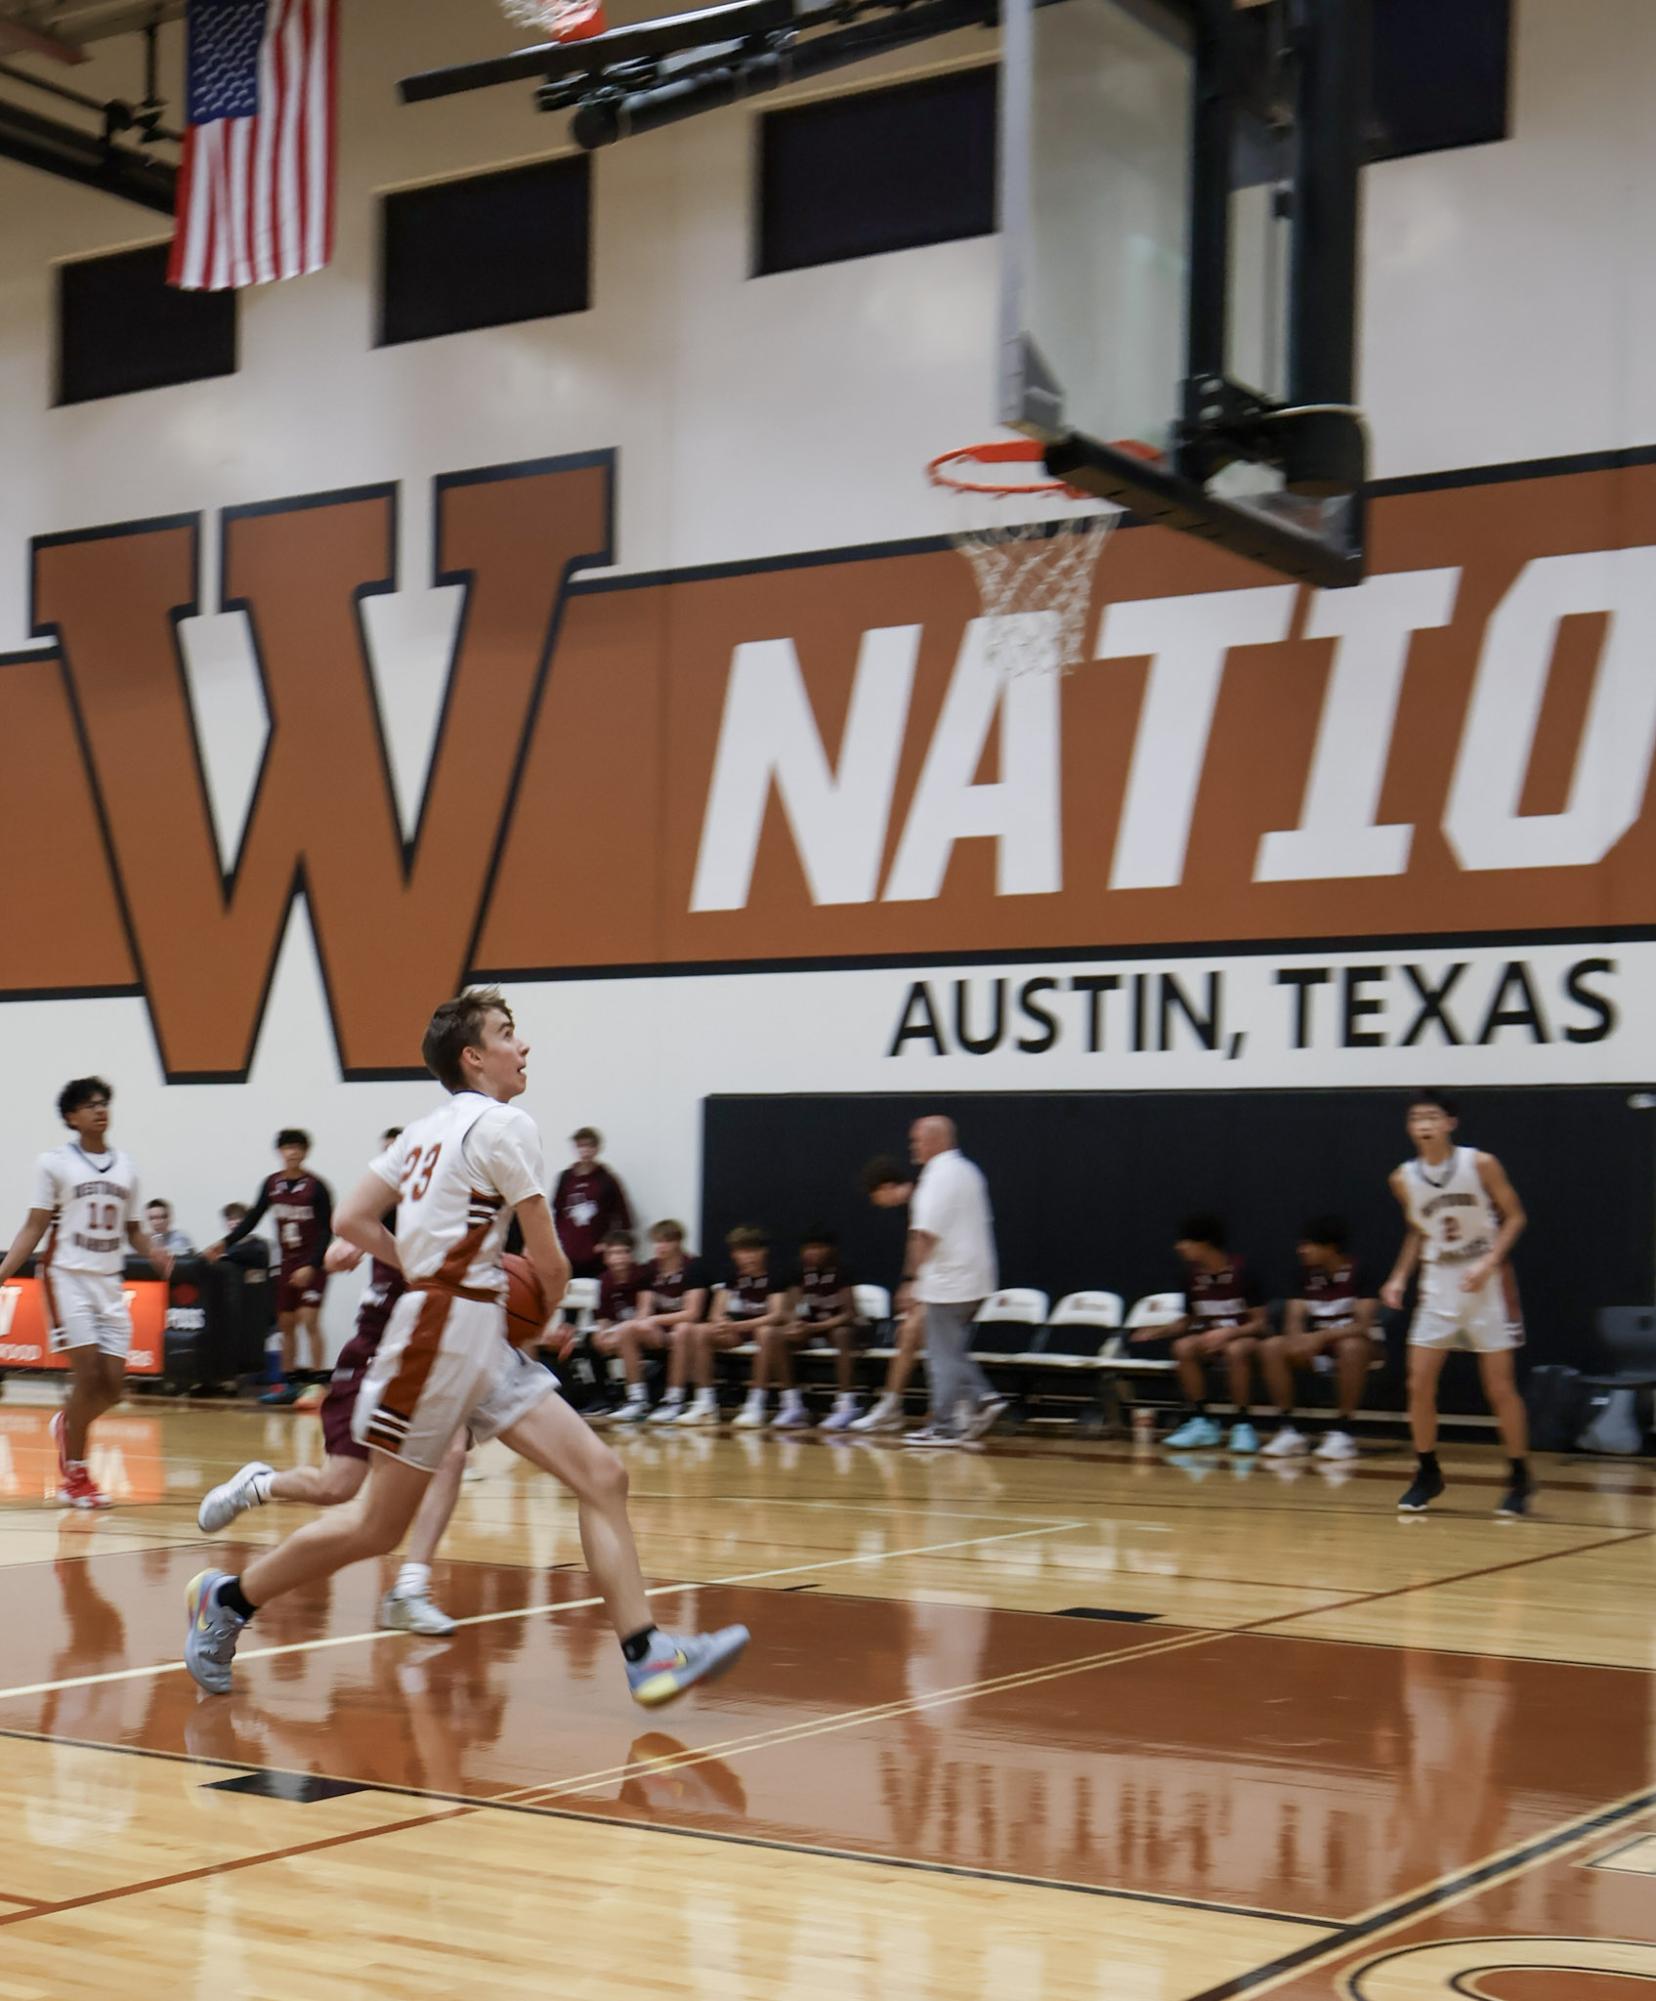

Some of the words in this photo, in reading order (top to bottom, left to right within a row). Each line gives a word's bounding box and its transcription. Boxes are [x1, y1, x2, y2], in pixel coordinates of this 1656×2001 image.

[28, 446, 619, 1085] W
[688, 545, 1656, 912] NATIO
[885, 969, 1247, 1060] AUSTIN,
[1275, 957, 1619, 1049] TEXAS
[88, 1202, 118, 1230] 10
[401, 1143, 442, 1201] 23
